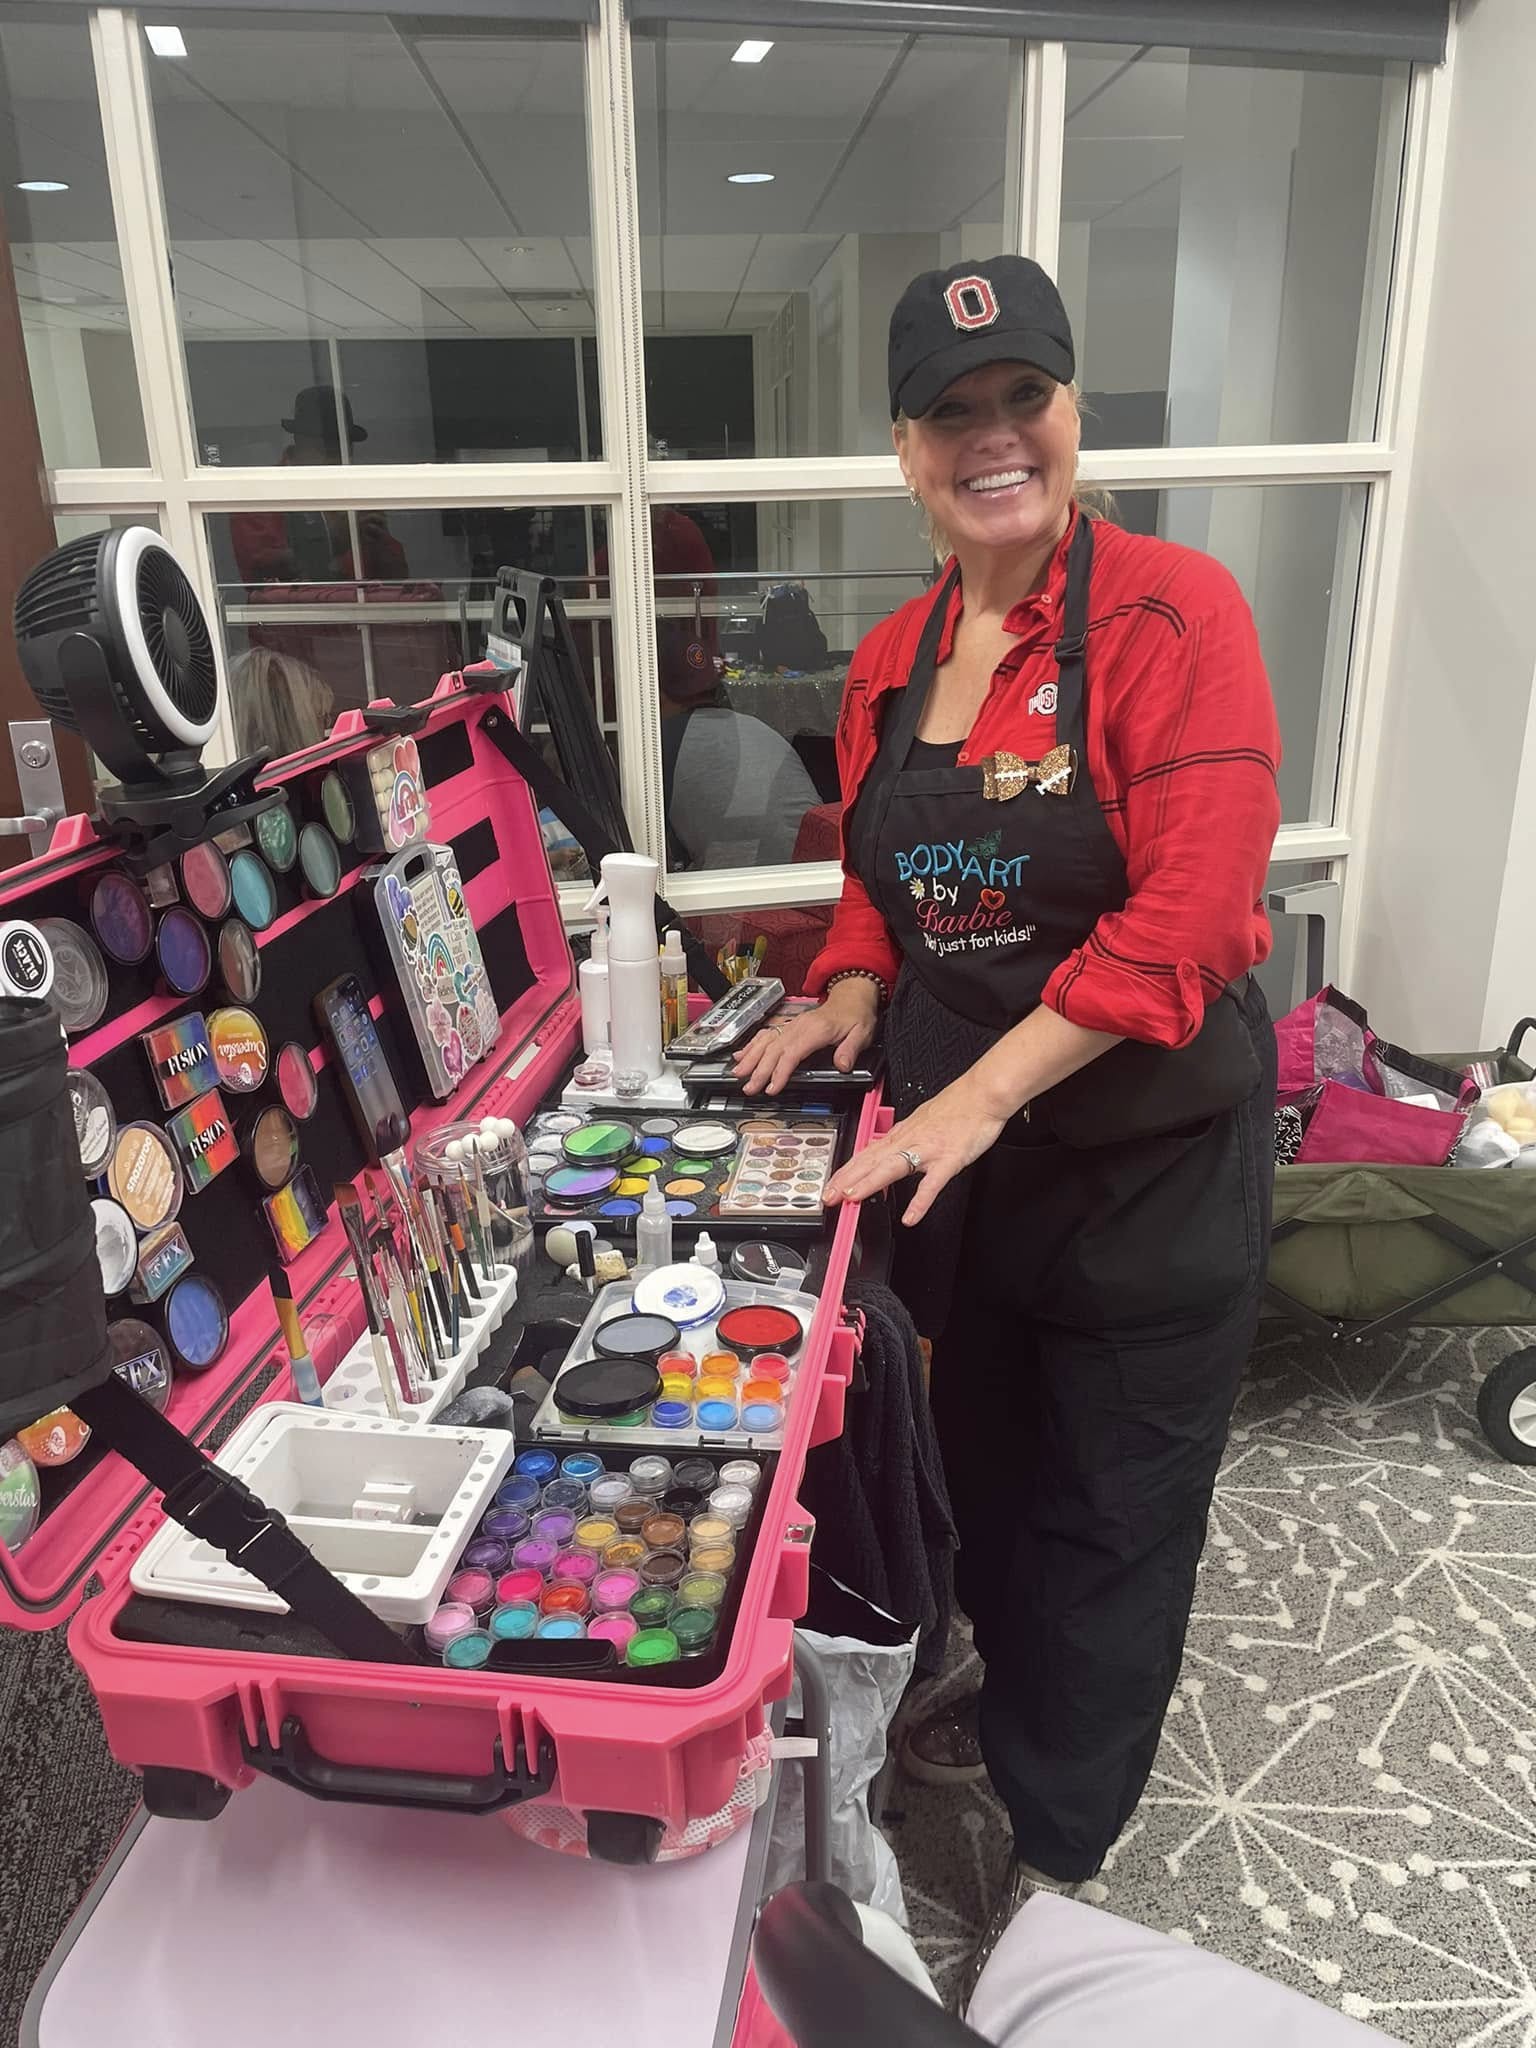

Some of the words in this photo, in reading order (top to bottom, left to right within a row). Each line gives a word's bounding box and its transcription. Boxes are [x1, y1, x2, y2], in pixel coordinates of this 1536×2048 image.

[943, 275, 1000, 332] O
[895, 839, 965, 881] BODY
[960, 854, 1031, 887] ART
[932, 877, 959, 906] by
[915, 898, 1013, 934] Barbie
[13, 939, 40, 981] BLACK
[937, 937, 967, 957] just
[968, 933, 993, 951] for
[167, 1041, 209, 1076] FUSION
[218, 1039, 267, 1070] Superstar
[188, 1118, 227, 1159] FUSION
[126, 1135, 153, 1193] snazaroo
